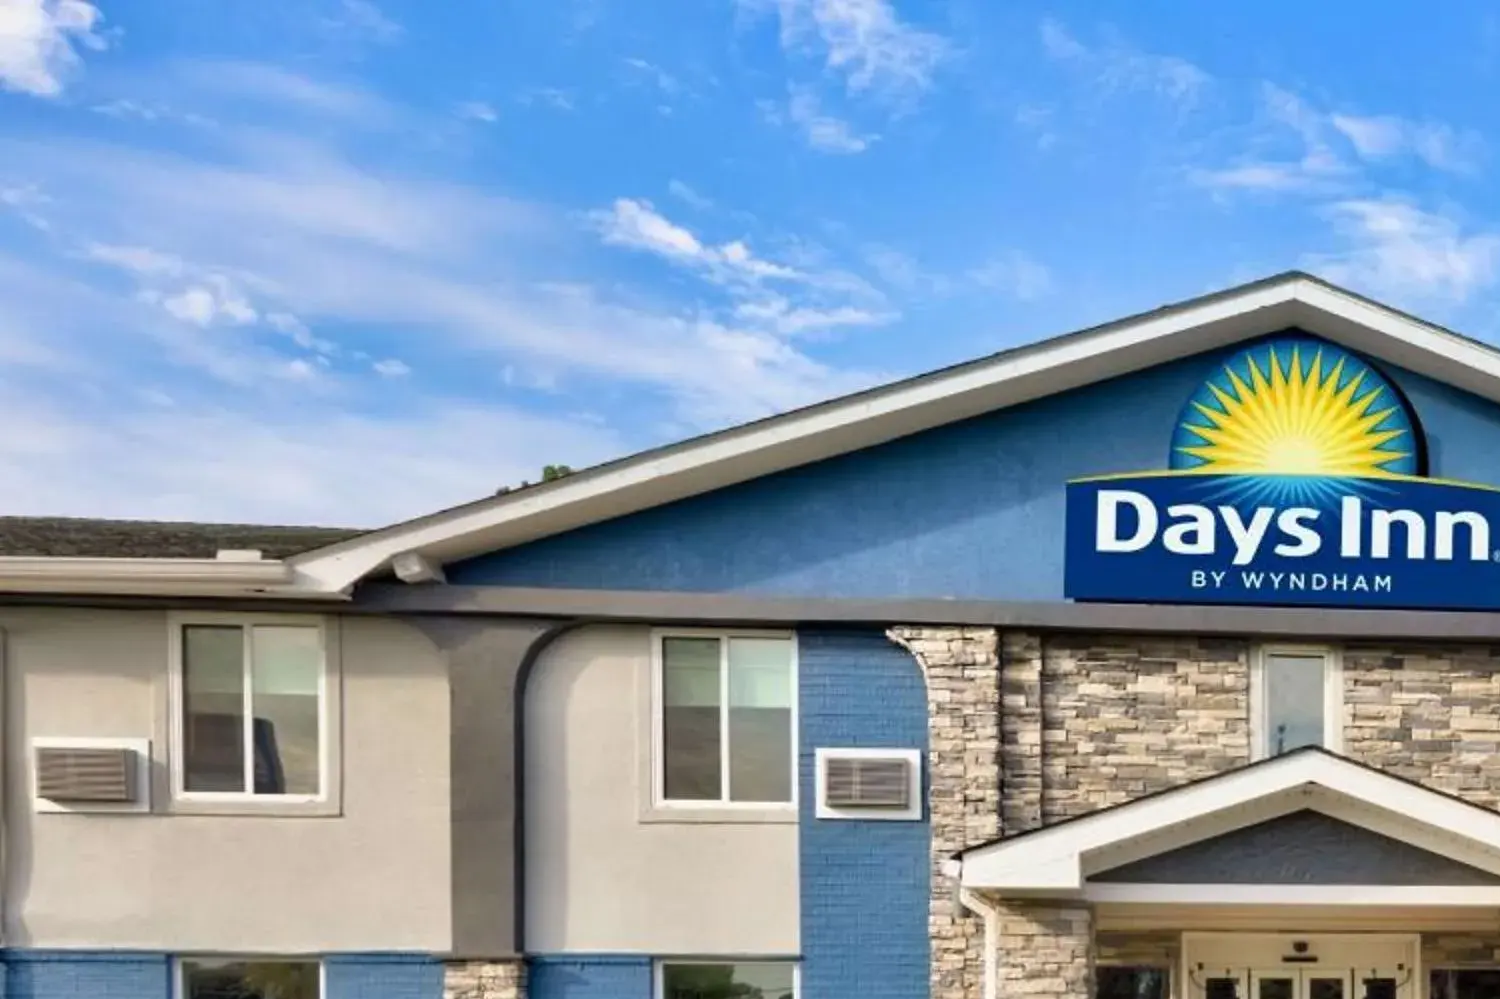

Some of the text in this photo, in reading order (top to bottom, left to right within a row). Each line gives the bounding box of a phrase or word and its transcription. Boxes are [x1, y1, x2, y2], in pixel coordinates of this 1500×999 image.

[1095, 489, 1489, 565] Days Inn
[1192, 571, 1392, 592] BY WYNDHAM
